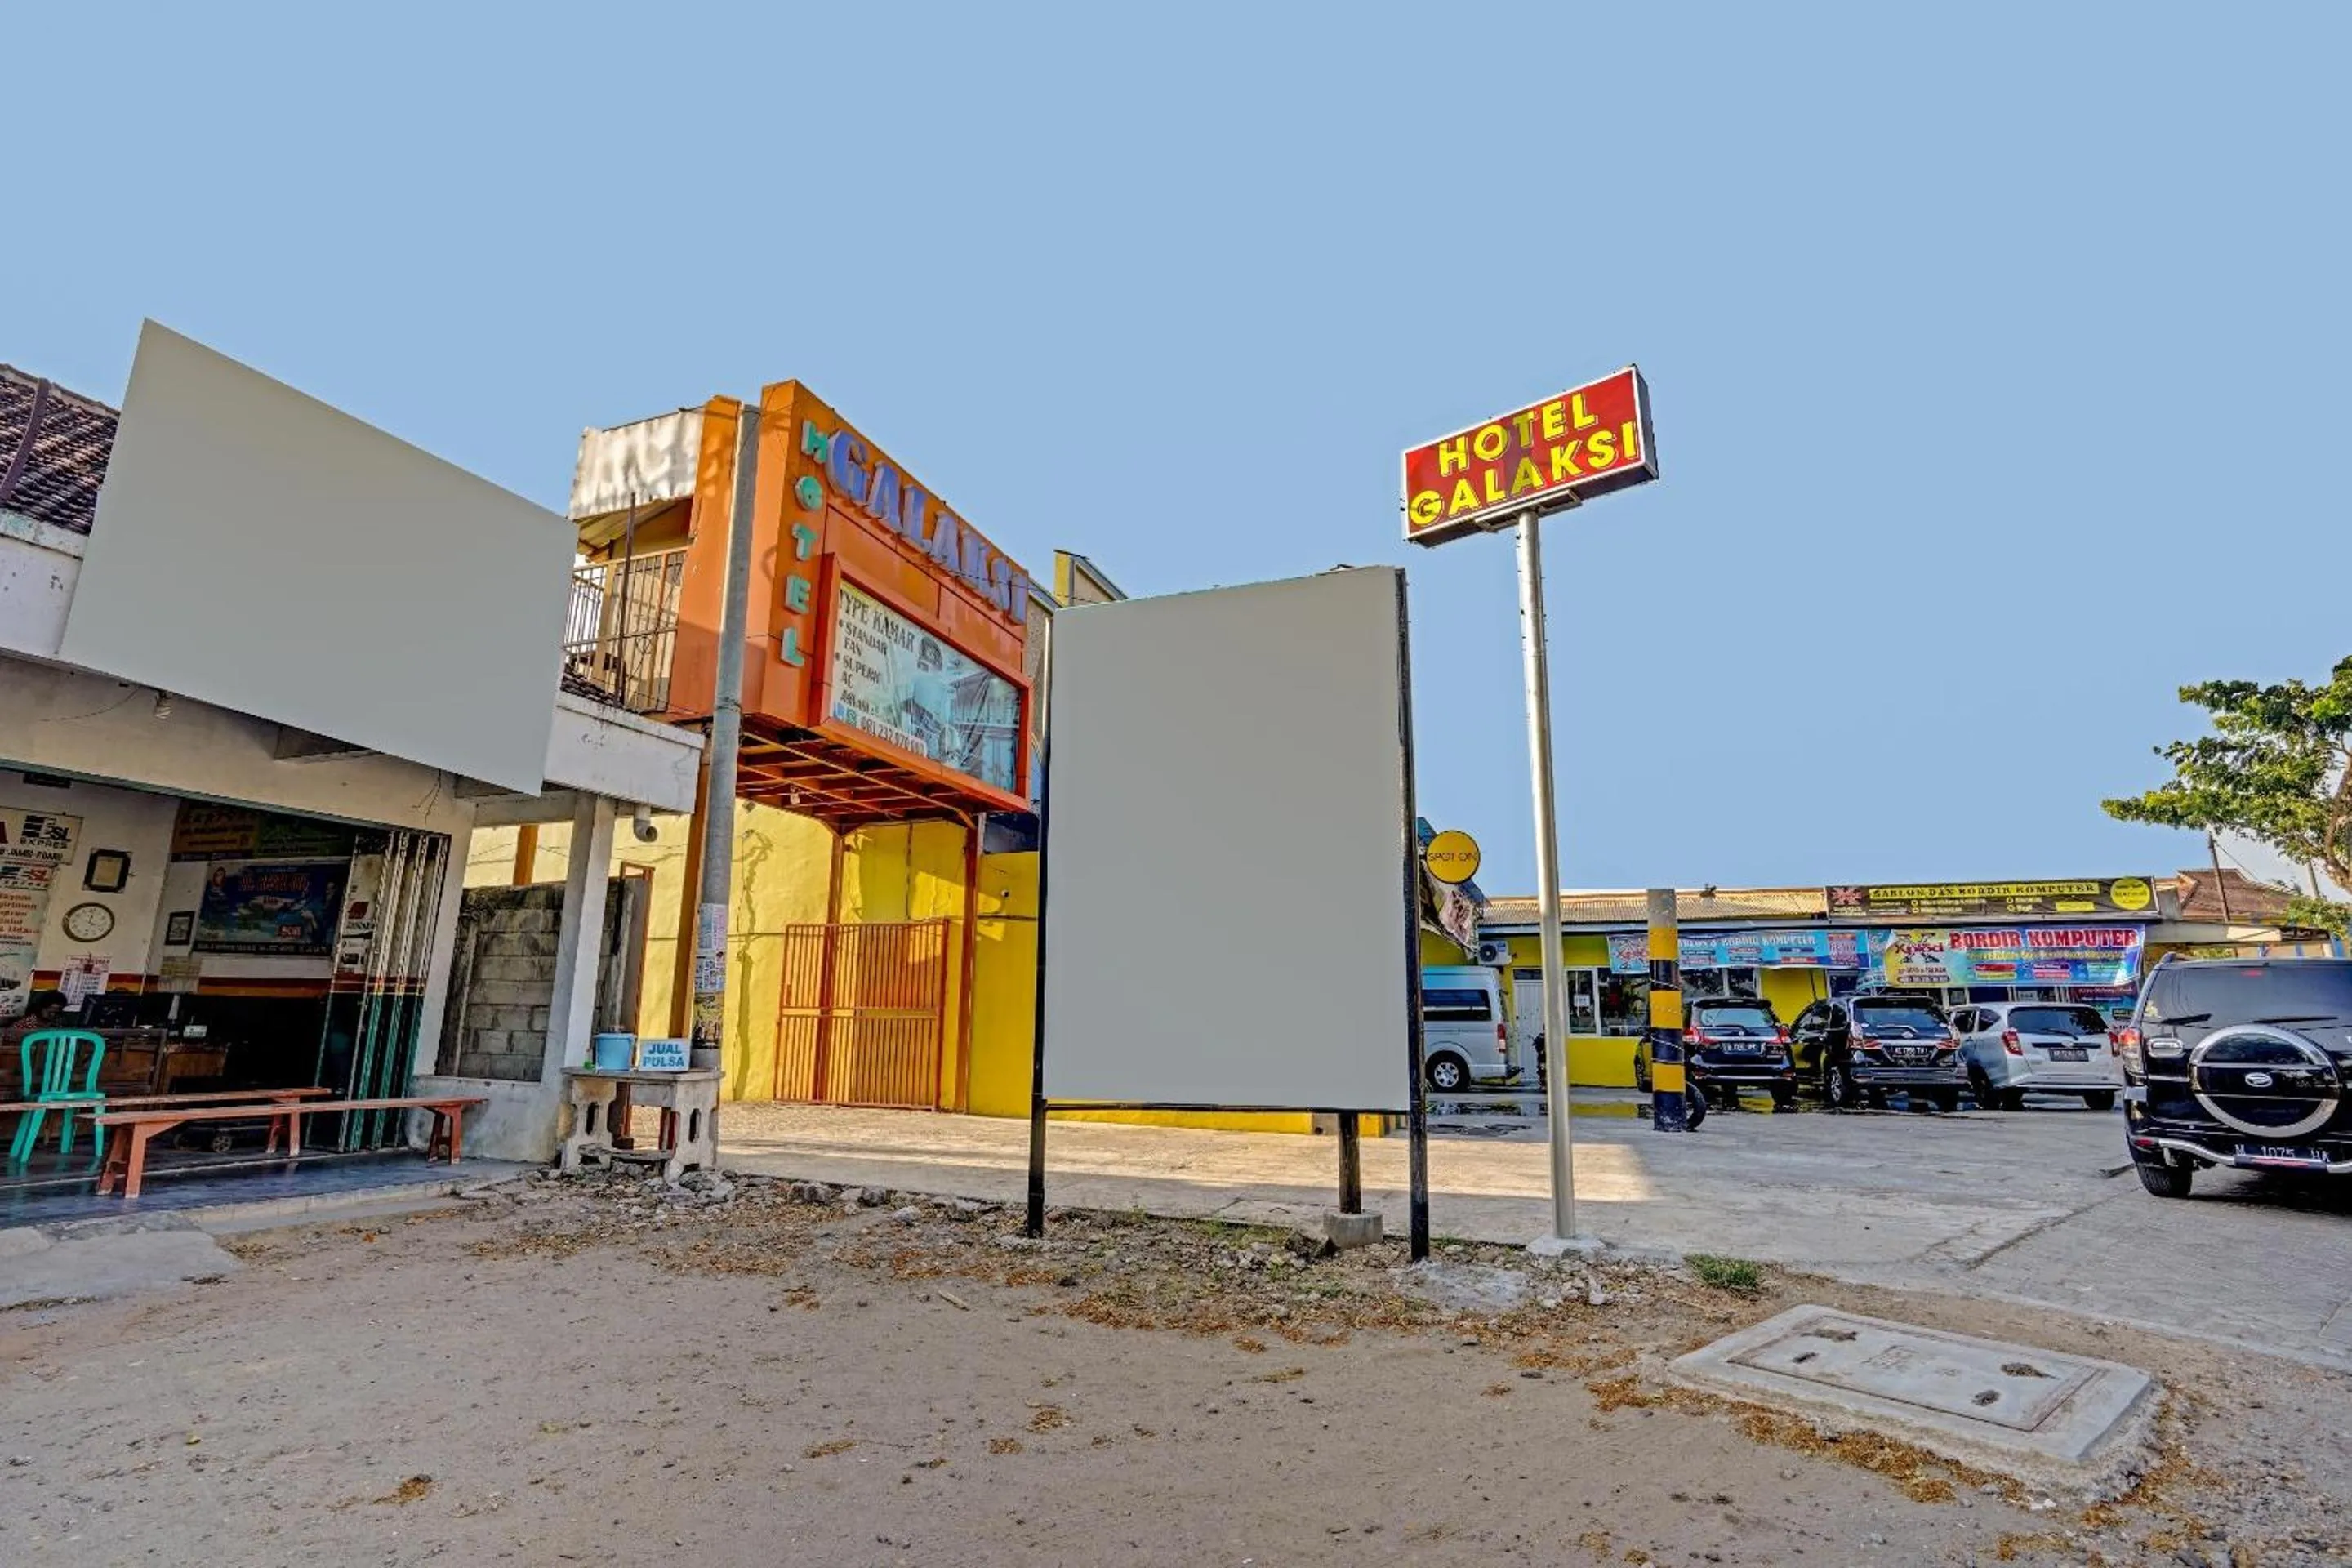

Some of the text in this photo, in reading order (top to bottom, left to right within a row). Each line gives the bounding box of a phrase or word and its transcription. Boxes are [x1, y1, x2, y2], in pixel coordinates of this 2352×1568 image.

[1438, 392, 1598, 477] HOTEL
[1409, 421, 1637, 526] GALAKSI
[781, 420, 829, 667] HOTEL
[824, 430, 1027, 626] GALAKSI
[873, 610, 915, 653] KAMAR
[1428, 852, 1477, 862] SPOT ON
[1873, 885, 2095, 898] SABLON DAN BORDIR KOMPUTER
[1949, 929, 2139, 949] BORDIR KOMPUTER
[643, 1056, 684, 1067] PULSA
[648, 1043, 683, 1054] JUAL
